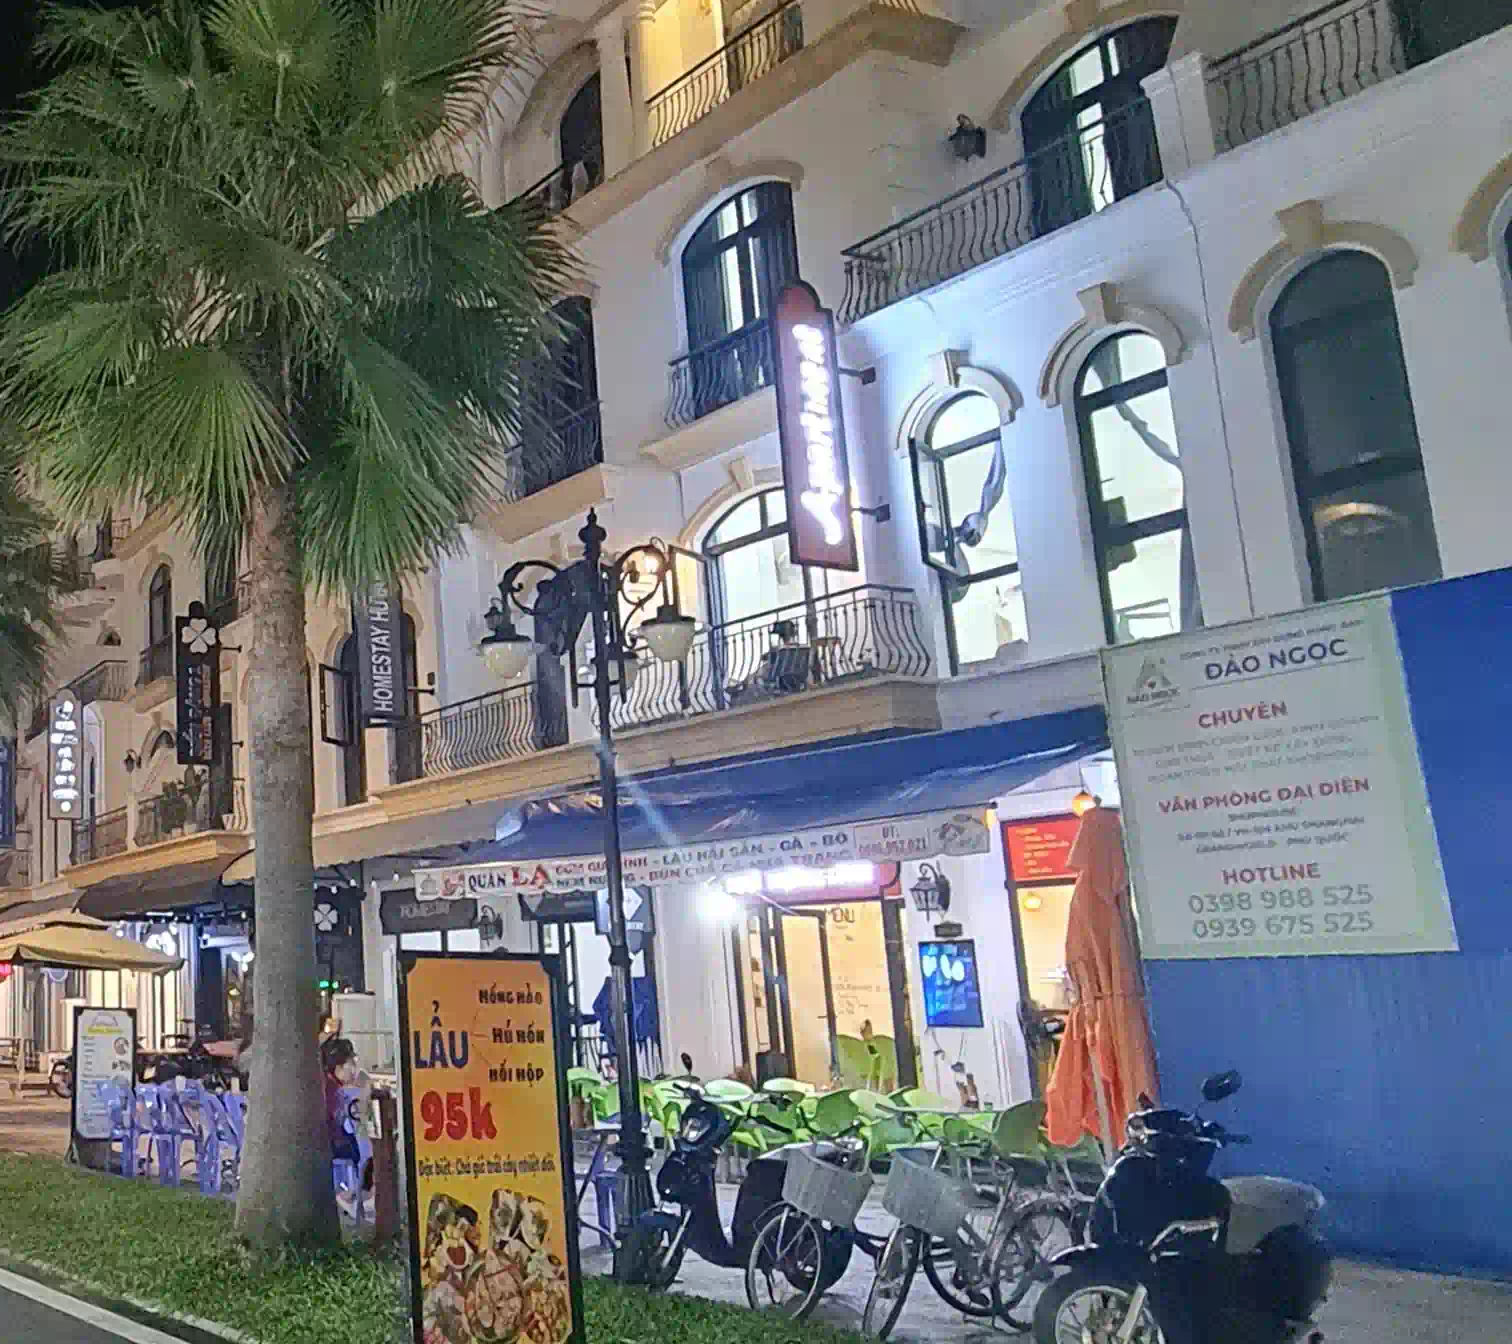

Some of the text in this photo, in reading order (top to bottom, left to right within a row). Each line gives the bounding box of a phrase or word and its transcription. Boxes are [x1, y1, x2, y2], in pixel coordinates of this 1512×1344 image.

[369, 625, 394, 712] HOMESTAY
[1221, 862, 1322, 886] HOTLINE
[1188, 883, 1374, 915] 0398 988 525
[1191, 910, 1375, 940] 0939 675 525
[413, 999, 469, 1069] LẨU
